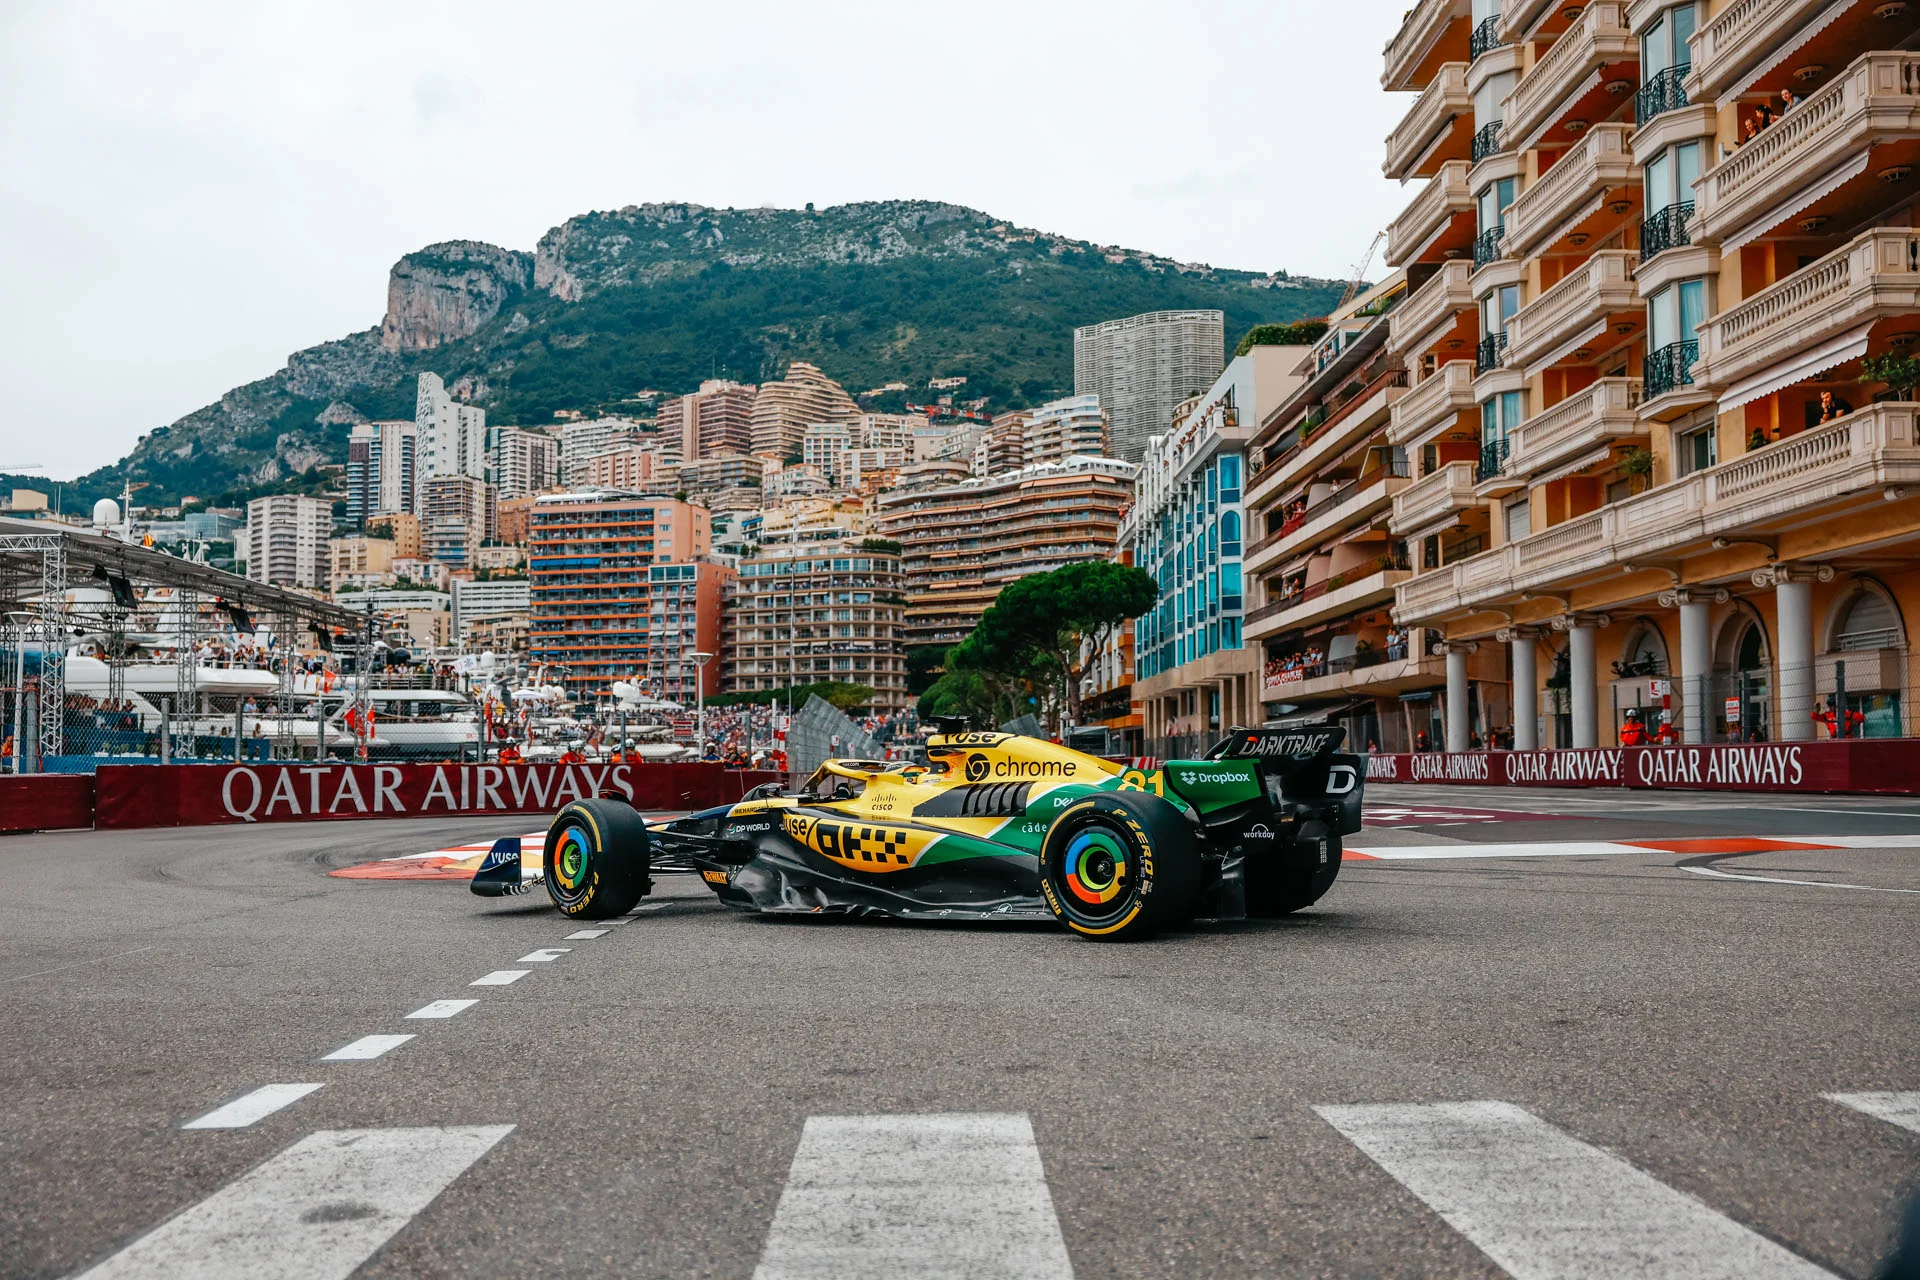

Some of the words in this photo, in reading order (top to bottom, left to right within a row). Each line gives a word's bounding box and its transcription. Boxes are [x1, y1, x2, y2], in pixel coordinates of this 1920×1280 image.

[1239, 733, 1331, 755] DARKTRACE
[995, 755, 1076, 777] chrome
[1198, 771, 1250, 784] Dropbox
[1366, 755, 1397, 778] IRWAYS
[1411, 755, 1444, 781] QATAR
[1446, 753, 1489, 780] AIRWAYS
[1506, 752, 1548, 783] QATAR
[1550, 749, 1625, 781] AIRWAY
[1638, 749, 1702, 785] QATAR
[1707, 746, 1803, 785] AIRWAYS
[1117, 770, 1164, 797] 81
[1325, 765, 1357, 794] D
[222, 766, 407, 822] QATAR
[420, 764, 635, 810] AIRWAYS
[1053, 797, 1073, 807] DE
[735, 825, 745, 833] DP
[746, 823, 771, 832] WORLD
[1243, 829, 1275, 840] workday
[1112, 808, 1128, 817] P
[1126, 819, 1154, 876] ZERO
[592, 871, 600, 885] P
[569, 885, 596, 914] ZERO
